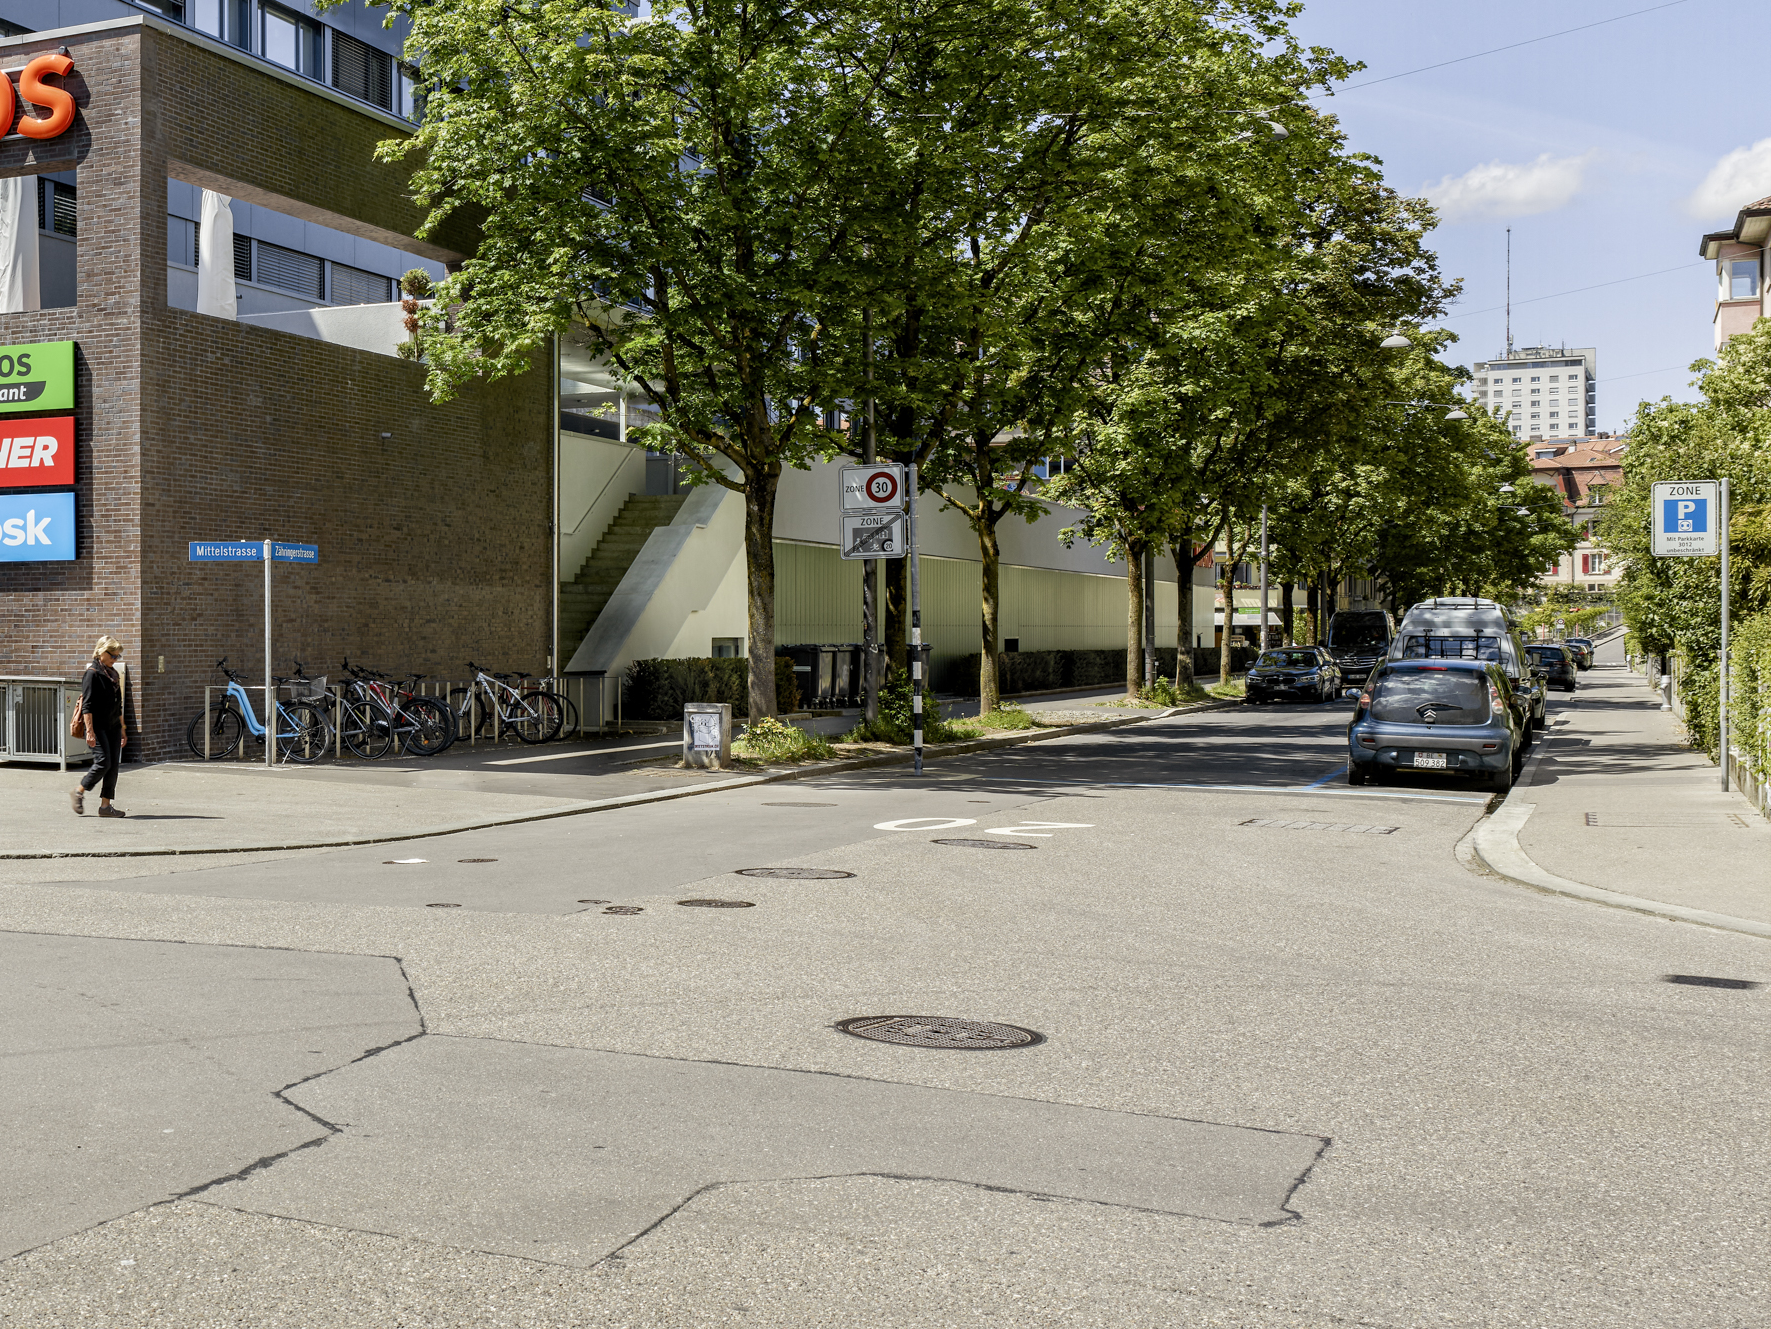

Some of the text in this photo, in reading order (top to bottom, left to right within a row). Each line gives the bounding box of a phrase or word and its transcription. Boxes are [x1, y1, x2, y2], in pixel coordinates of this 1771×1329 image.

[845, 482, 888, 493] ZONE 30
[1669, 486, 1701, 496] ZONE
[1678, 501, 1696, 519] P
[860, 517, 884, 526] ZONE
[196, 546, 257, 557] Mittelstrasse
[275, 545, 315, 560] Zähringerstrasse
[1415, 759, 1446, 768] 509 382
